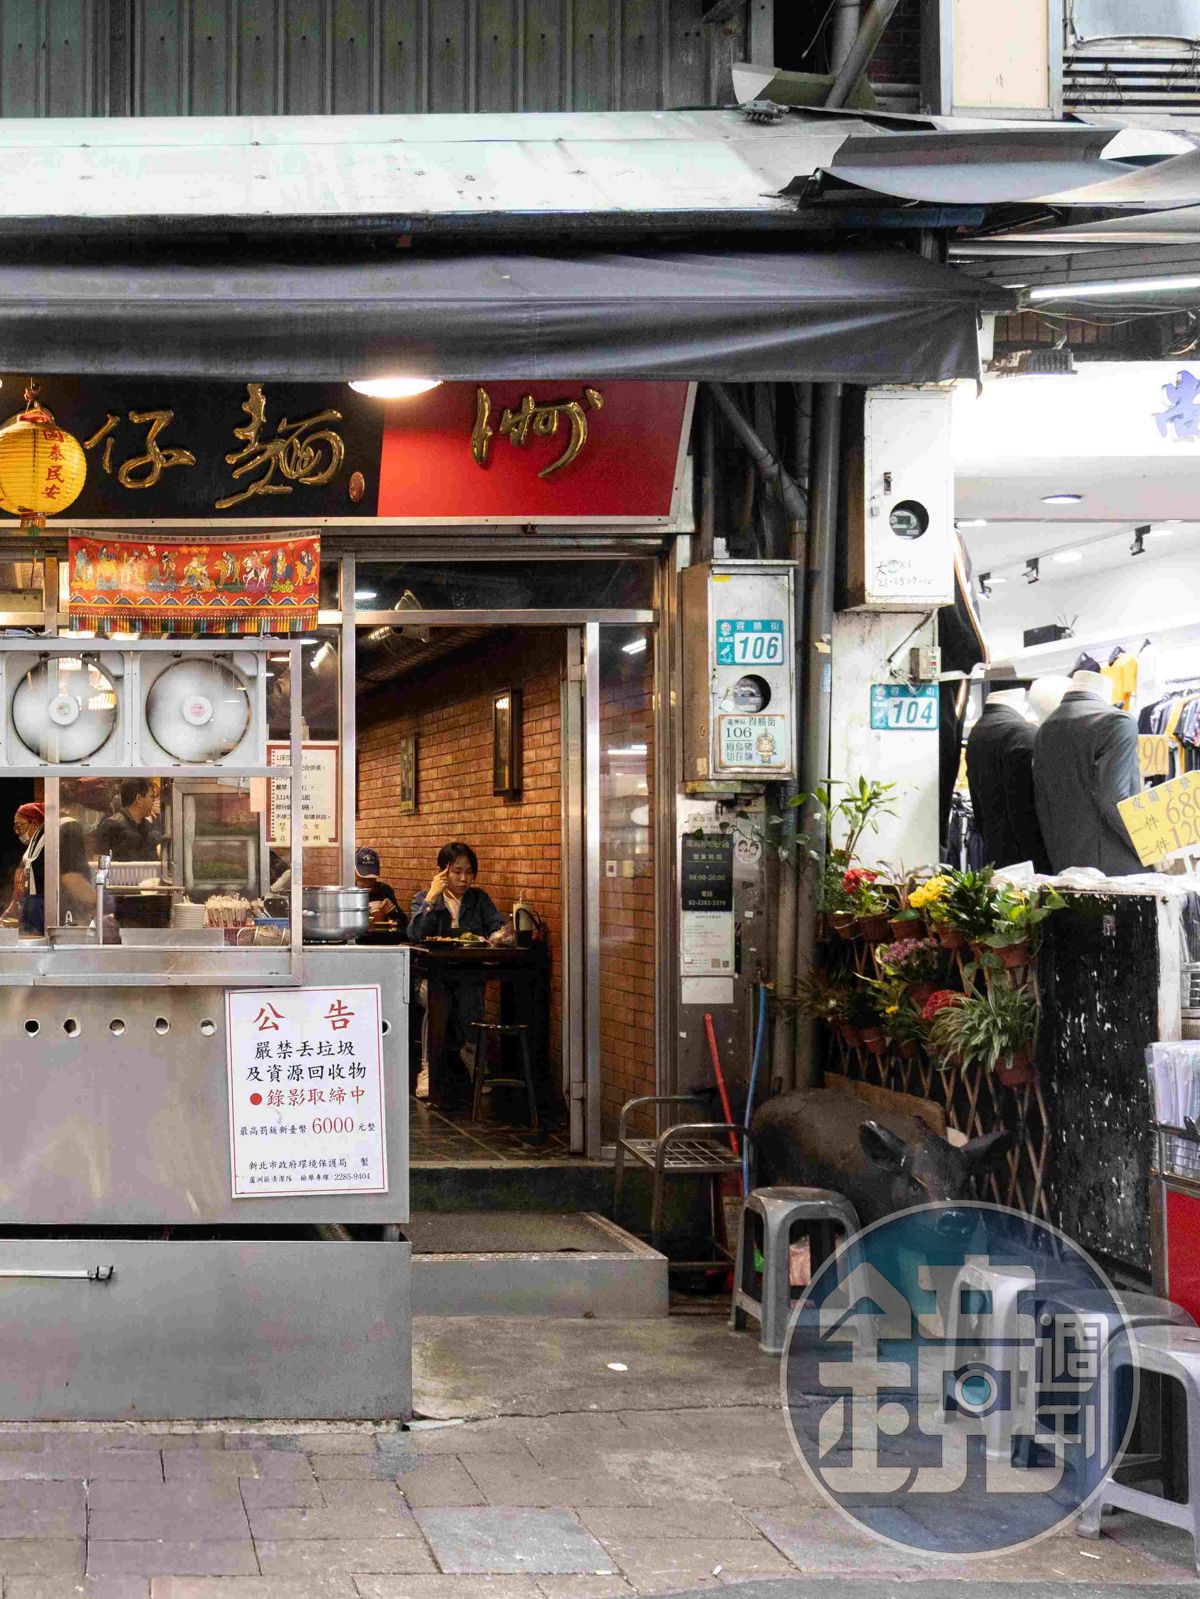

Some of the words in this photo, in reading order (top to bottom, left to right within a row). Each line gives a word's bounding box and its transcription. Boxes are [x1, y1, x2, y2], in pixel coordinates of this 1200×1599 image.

[739, 636, 779, 660] 106
[893, 701, 933, 724] 104
[726, 727, 752, 738] 106
[1137, 738, 1166, 772] 90
[253, 1000, 356, 1031] 公告
[254, 1040, 356, 1060] 嚴禁丟垃圾
[246, 1062, 367, 1083] 及資源回收物
[266, 1085, 366, 1107] 錄影取締中
[312, 1116, 354, 1134] 6000
